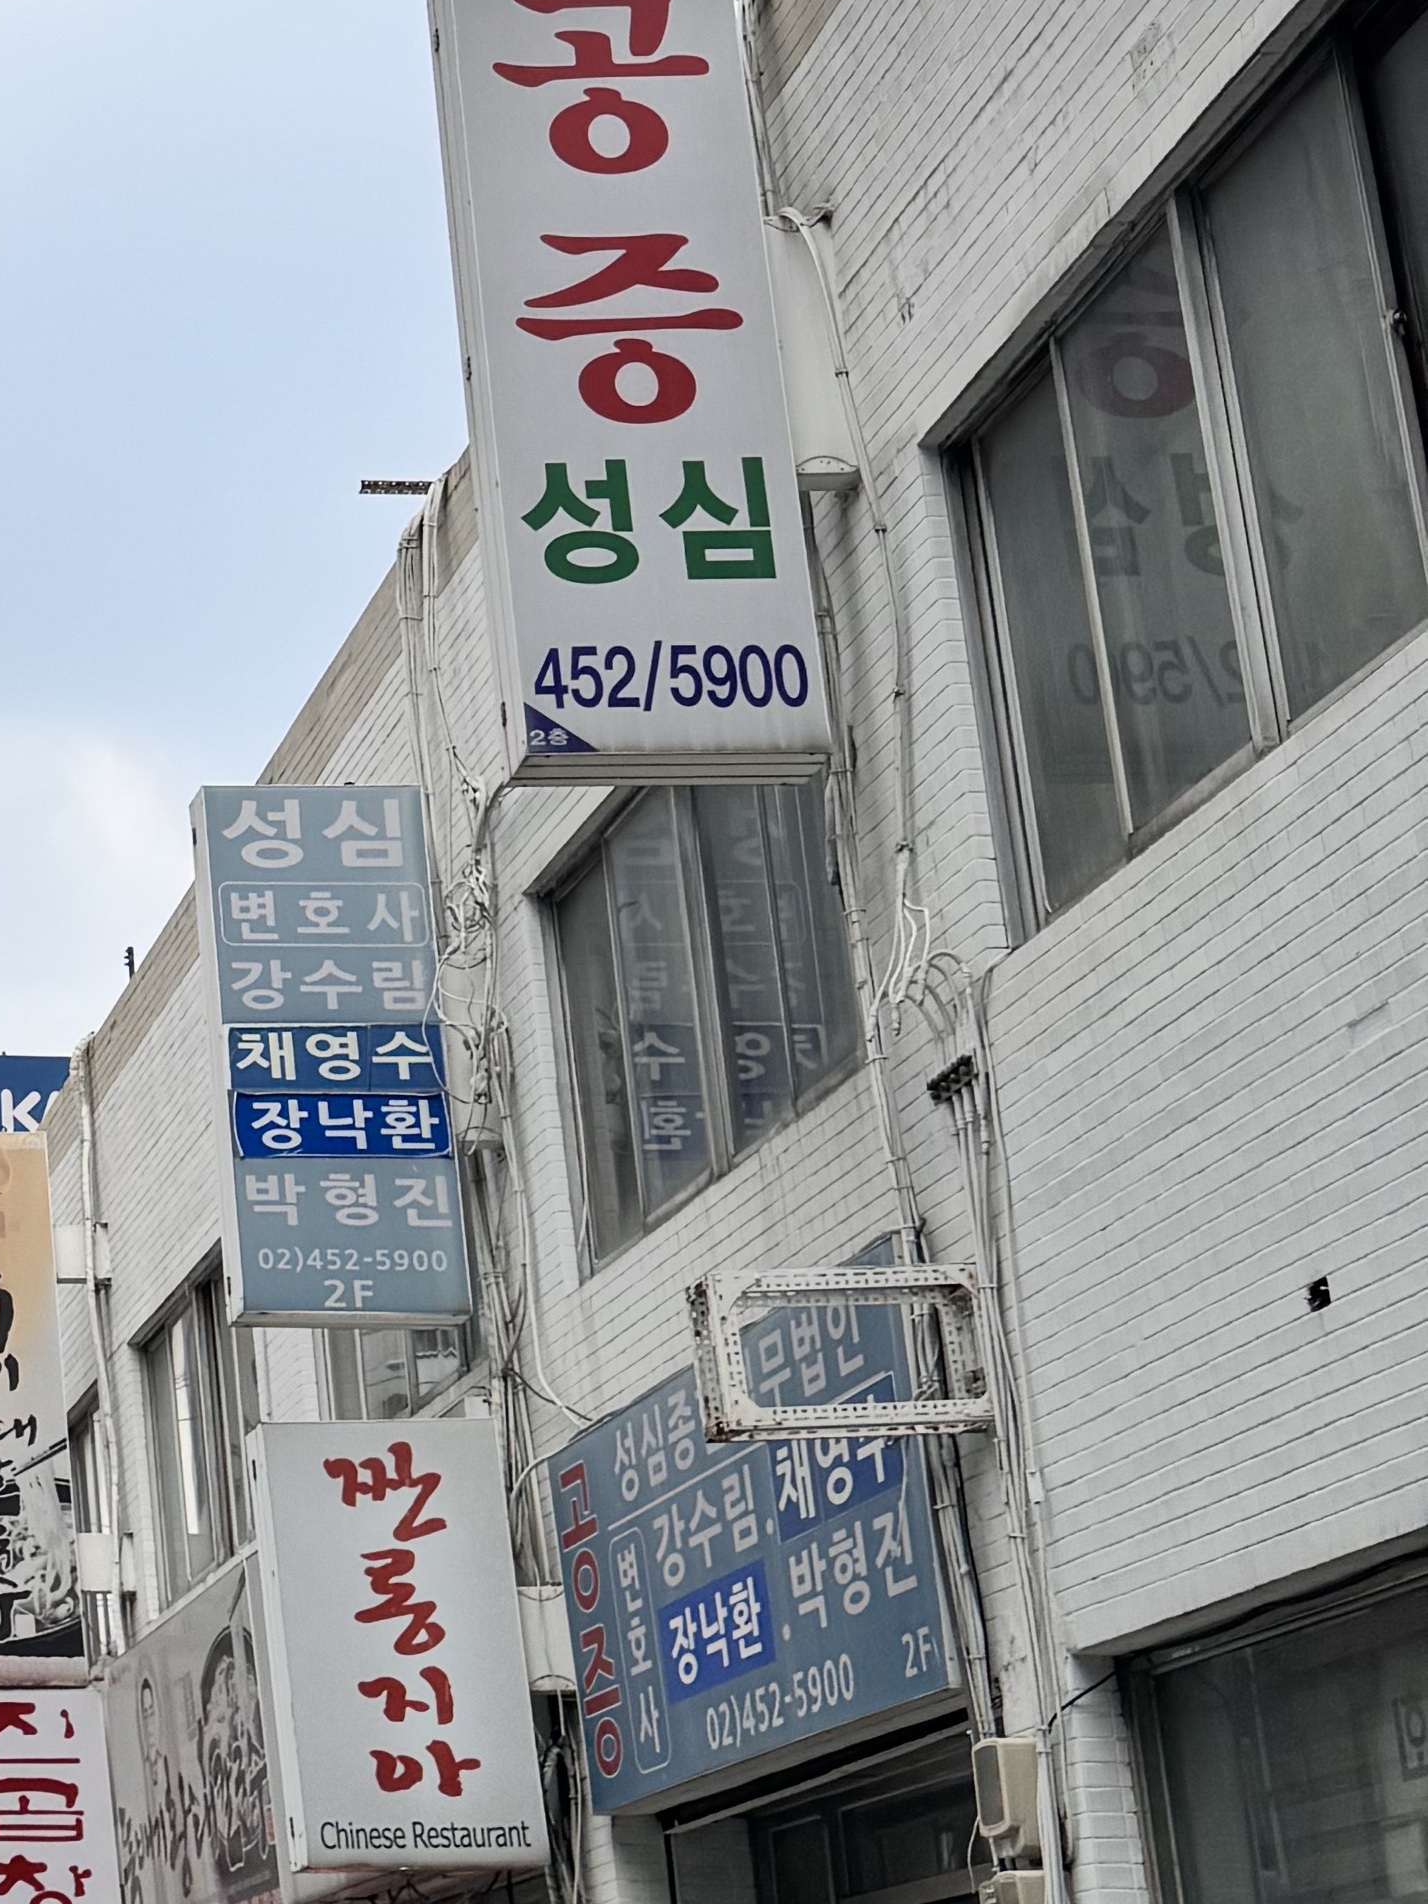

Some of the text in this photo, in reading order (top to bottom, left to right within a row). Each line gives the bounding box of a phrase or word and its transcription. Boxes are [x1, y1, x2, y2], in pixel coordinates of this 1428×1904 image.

[522, 456, 778, 585] 성심
[534, 641, 808, 711] 452/5900
[529, 728, 568, 747] 2층
[222, 798, 404, 868] 성심
[231, 891, 419, 942] 변호사
[231, 959, 425, 1009] 강수림
[236, 1031, 432, 1081] 채영수
[251, 1099, 439, 1151] 장낙환
[244, 1173, 453, 1228] 박형진
[258, 1248, 447, 1274] 02)452-5900
[324, 1280, 374, 1308] 2F
[653, 1464, 758, 1587] 강수림
[789, 1509, 918, 1629] 박형진
[560, 1460, 622, 1778] 공증
[669, 1576, 762, 1685] 장낙환
[617, 1540, 662, 1754] 변호사
[902, 1628, 933, 1679] 2F
[706, 1653, 855, 1751] 02)452-5900
[320, 1819, 532, 1852] Chinese Restaurant
